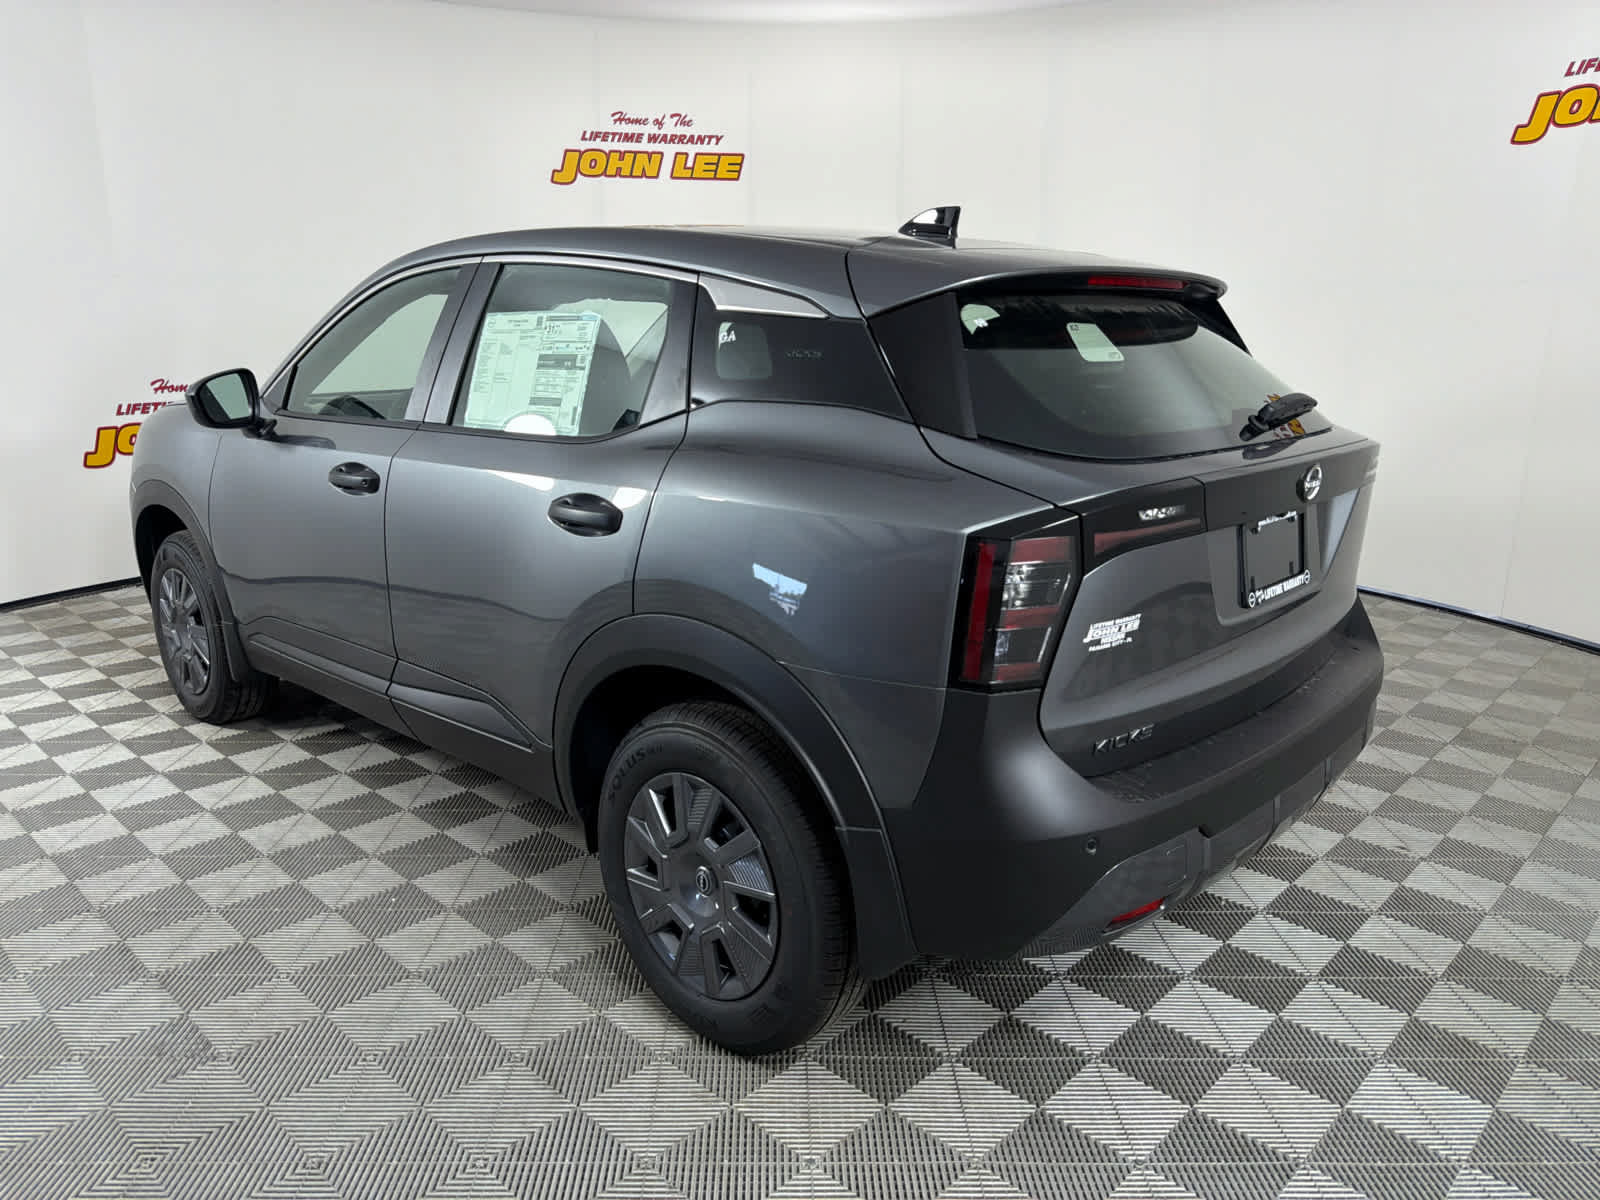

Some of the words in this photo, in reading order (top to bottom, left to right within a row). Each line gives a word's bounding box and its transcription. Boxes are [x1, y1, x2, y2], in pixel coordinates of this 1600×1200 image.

[611, 111, 649, 126] Home
[652, 114, 665, 130] of
[670, 112, 693, 128] The
[581, 130, 644, 144] LIFETIME
[647, 132, 724, 146] WARRANTY
[551, 148, 664, 185] JOHN
[670, 151, 745, 181] LEE
[150, 378, 188, 394] Hom
[83, 422, 142, 469] JO
[1092, 723, 1155, 755] KICKS
